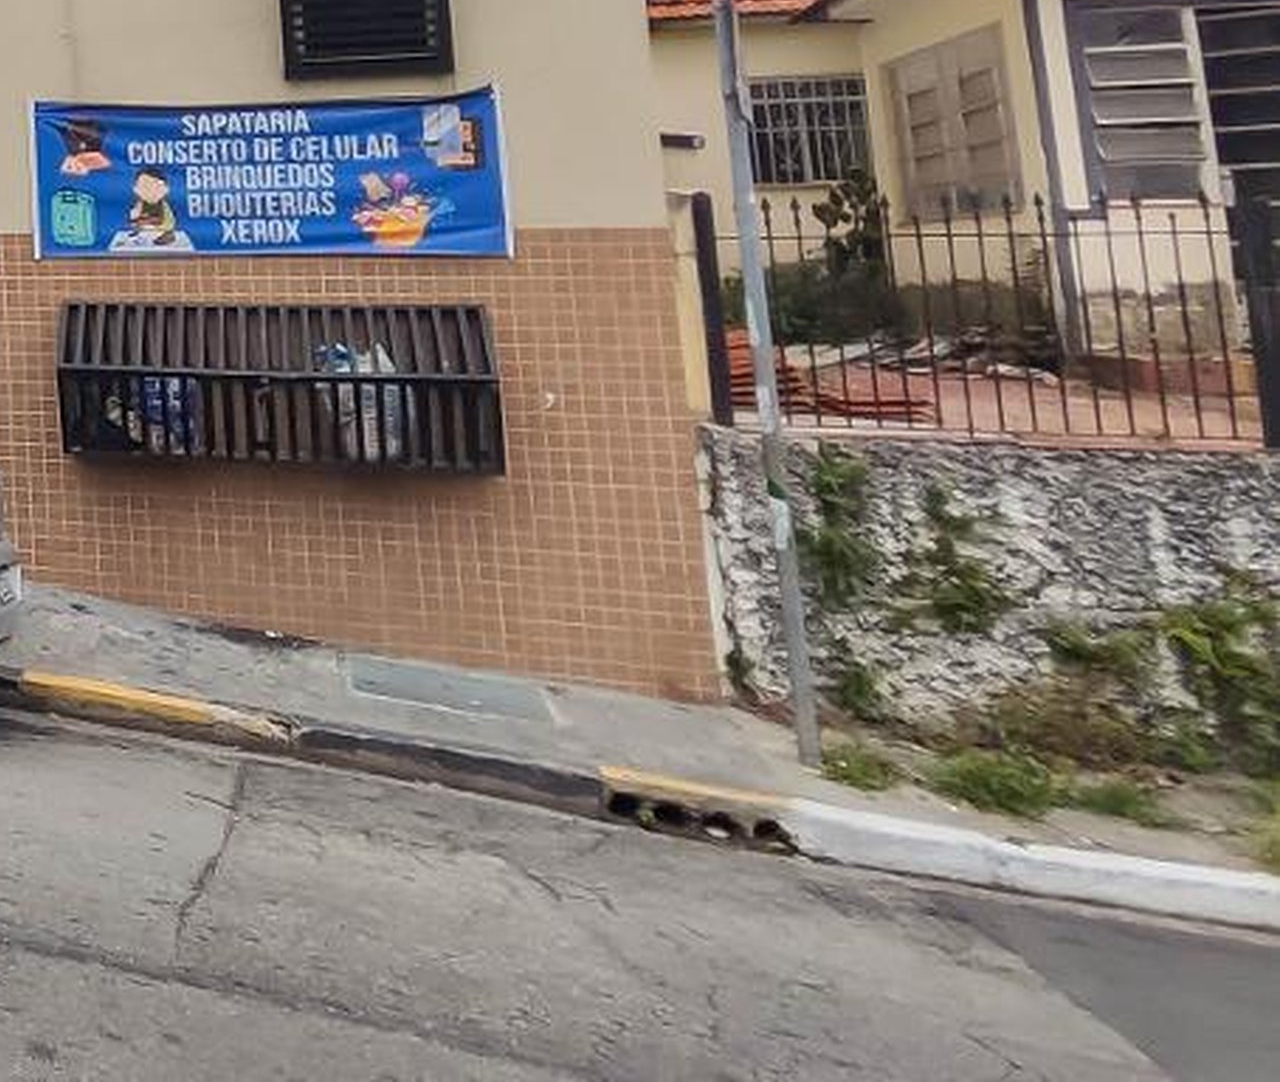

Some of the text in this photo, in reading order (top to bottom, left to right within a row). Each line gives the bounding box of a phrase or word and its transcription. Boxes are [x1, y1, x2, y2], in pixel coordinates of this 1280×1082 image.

[181, 109, 311, 136] SAPATARIA
[127, 134, 399, 165] CONSERTO DE CELULAR
[186, 163, 335, 190] BRINQUEDOS
[188, 191, 336, 217] BIJOUTERIAS
[220, 219, 302, 244] XEROX
